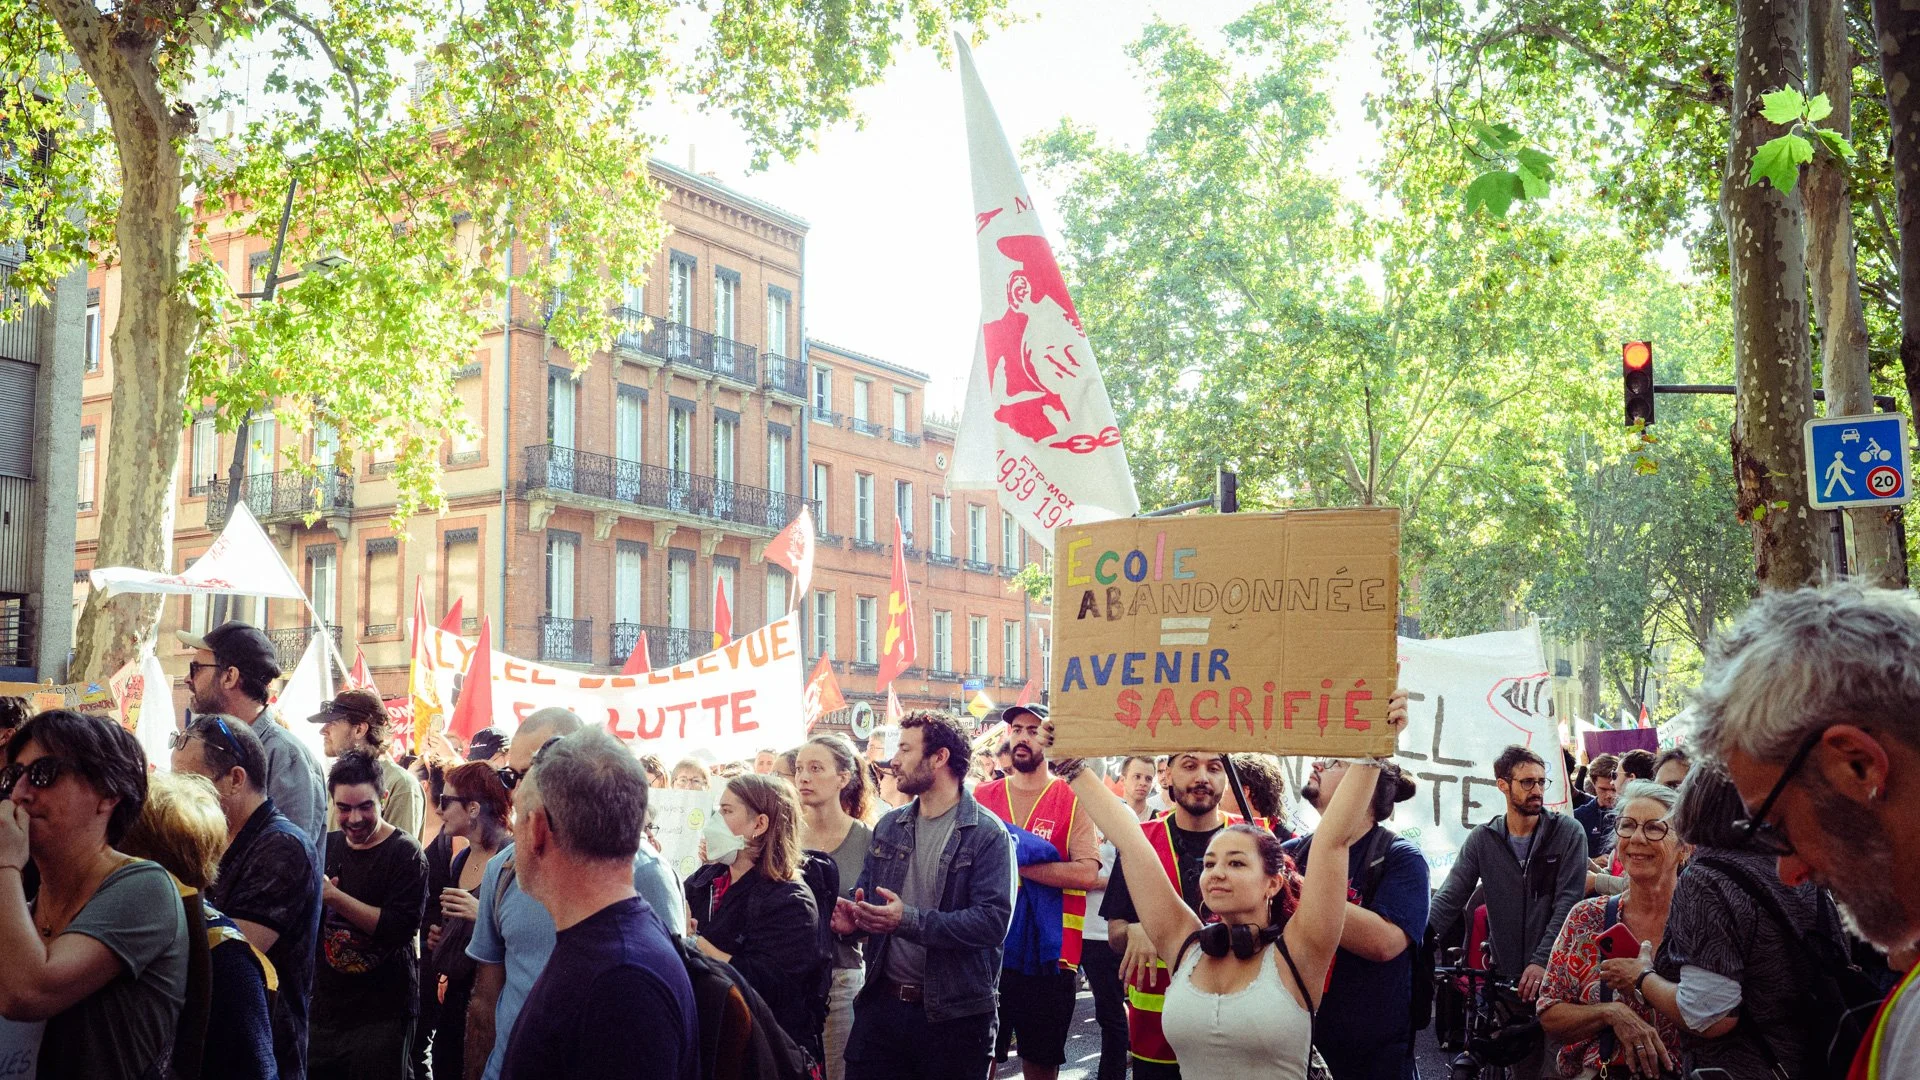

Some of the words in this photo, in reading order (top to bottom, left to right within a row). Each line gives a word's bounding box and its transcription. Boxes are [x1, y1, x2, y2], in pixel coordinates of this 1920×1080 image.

[1020, 455, 1075, 511] FTP-MOI
[1874, 475, 1894, 488] 20
[1076, 566, 1386, 622] ABANDONNÉE
[1061, 648, 1231, 693] AVENIR
[79, 697, 116, 713] POGNON
[606, 689, 759, 740] LUTTE
